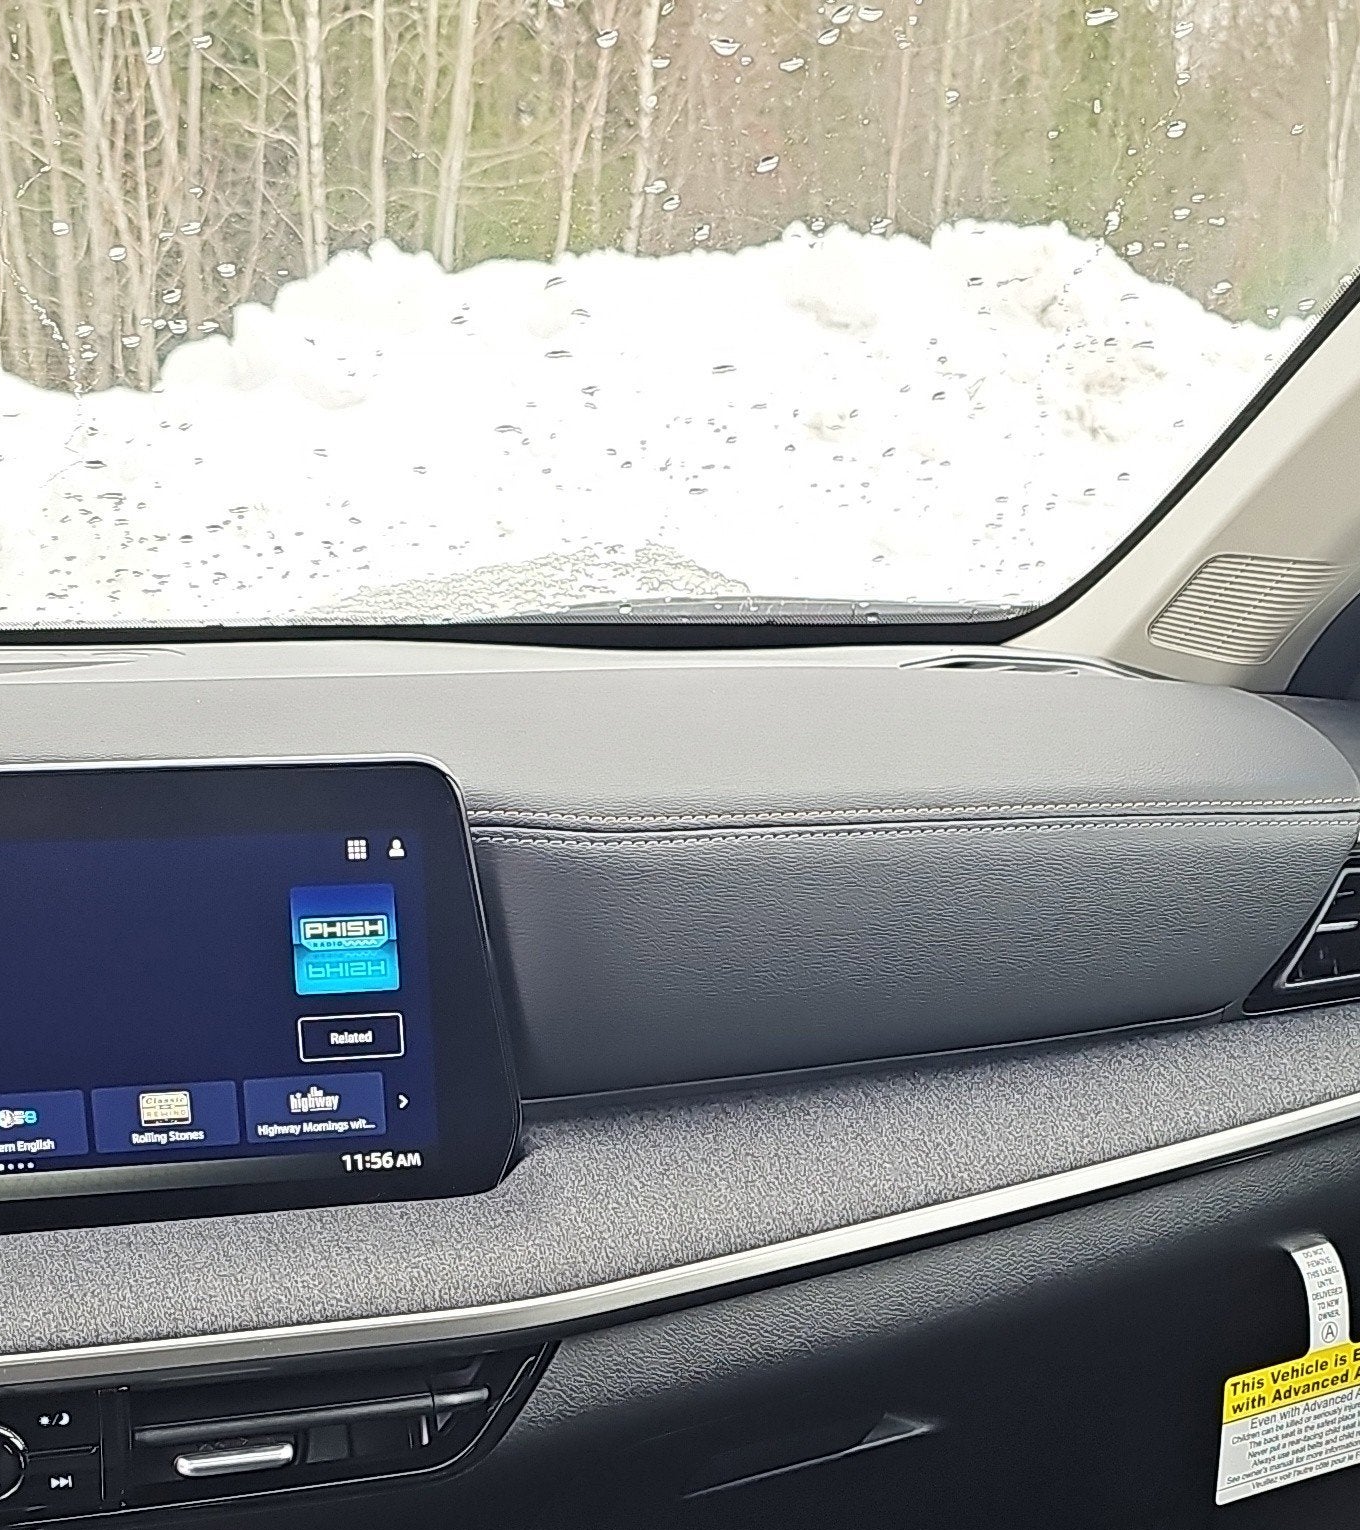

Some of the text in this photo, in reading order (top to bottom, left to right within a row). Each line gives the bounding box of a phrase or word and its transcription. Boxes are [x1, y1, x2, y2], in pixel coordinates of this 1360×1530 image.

[305, 920, 384, 938] PHISH
[330, 1030, 373, 1045] Related
[290, 1092, 339, 1112] highway
[132, 1130, 205, 1145] Rolling Stones
[257, 1124, 301, 1137] Highway
[302, 1120, 349, 1134] Mornings
[17, 1139, 55, 1153] English
[342, 1152, 422, 1171] 11:56 AM
[1231, 1377, 1264, 1396] This
[1271, 1361, 1328, 1384] Vehicle
[1334, 1353, 1347, 1366] is
[1232, 1395, 1266, 1414] with
[1272, 1370, 1349, 1404] Advanced
[1251, 1414, 1276, 1429] Even
[1280, 1406, 1300, 1420] with
[1302, 1390, 1353, 1415] Advanced
